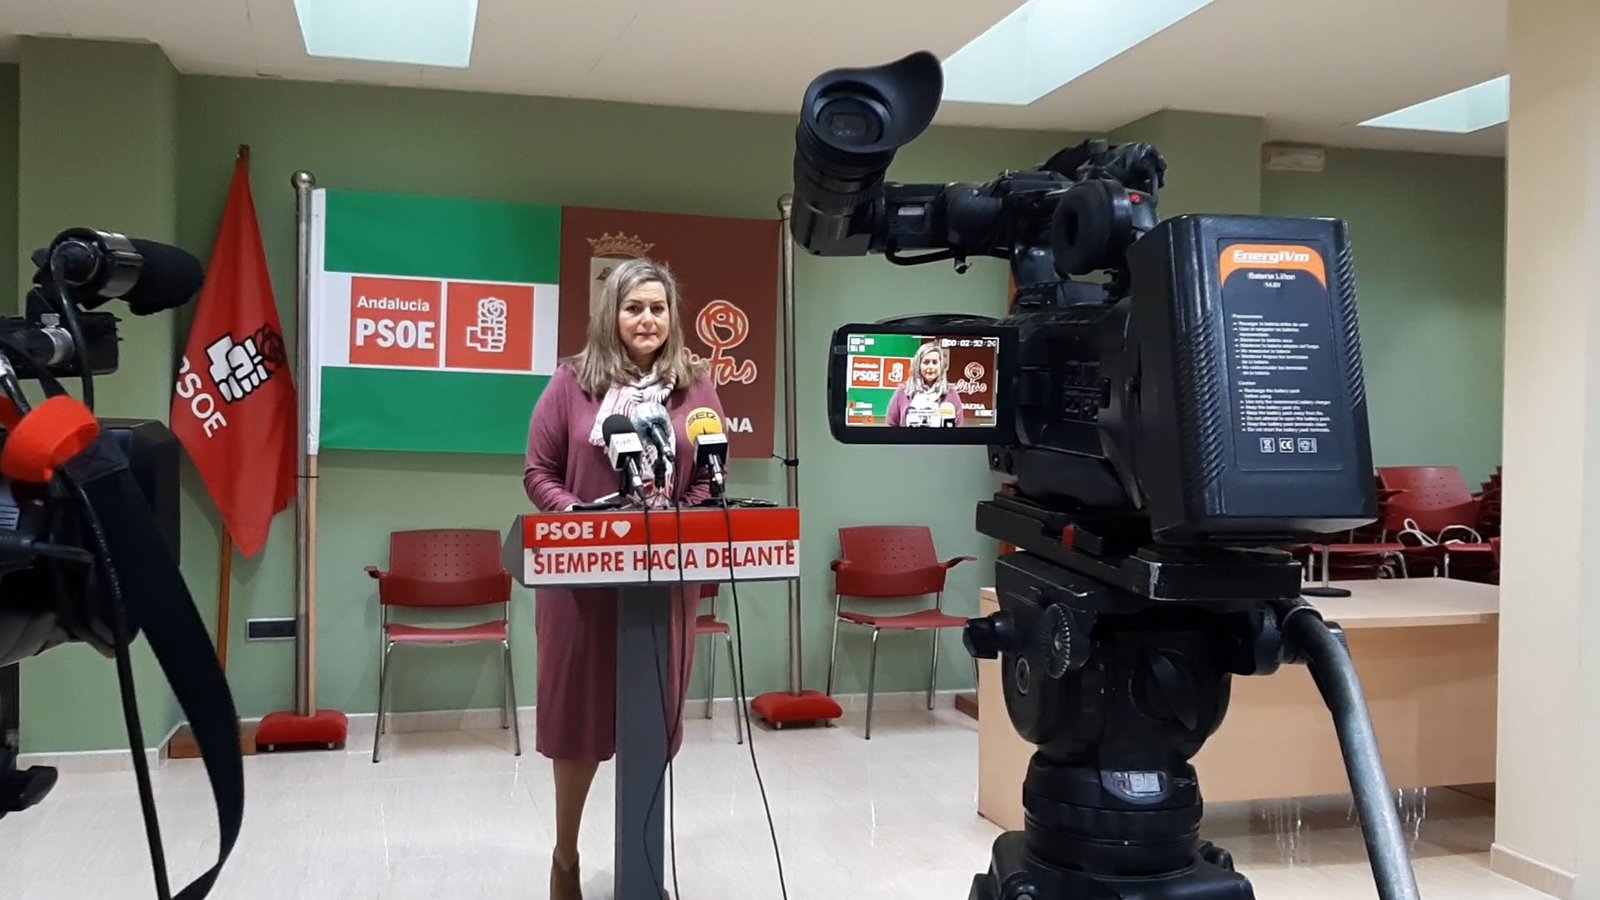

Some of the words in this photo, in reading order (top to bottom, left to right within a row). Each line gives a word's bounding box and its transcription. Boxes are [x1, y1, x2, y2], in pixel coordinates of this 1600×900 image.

[355, 318, 436, 349] PSOE
[853, 370, 880, 382] PSOE
[726, 417, 753, 432] NA
[535, 522, 595, 541] PSOE
[534, 551, 624, 575] SIEMPRE
[632, 549, 699, 571] HACA
[705, 545, 795, 568] DELANTE
